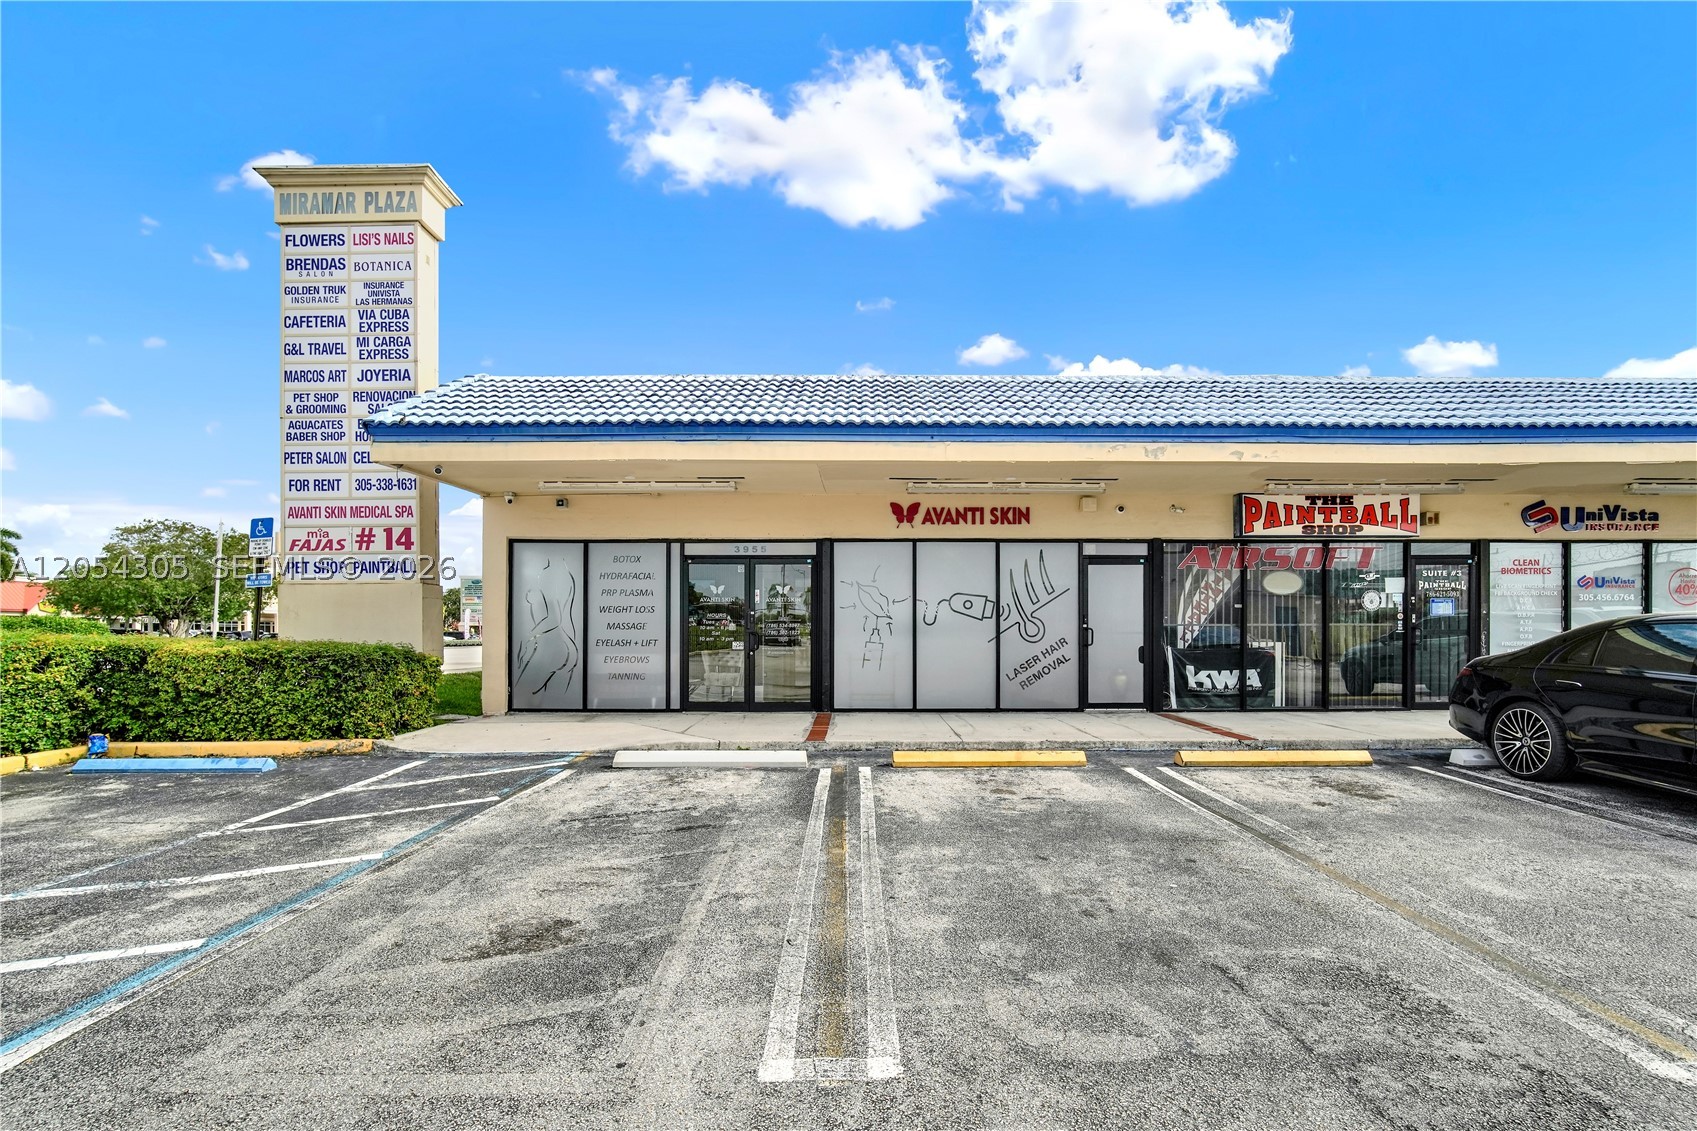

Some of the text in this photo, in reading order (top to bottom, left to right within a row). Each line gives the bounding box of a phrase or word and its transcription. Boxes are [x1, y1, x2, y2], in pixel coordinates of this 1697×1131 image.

[280, 191, 418, 215] MIRAMAR PLAZA
[285, 234, 346, 247] FLOWERS
[353, 232, 415, 246] LISI'S NAILS
[286, 258, 347, 271] BRENDAS
[354, 261, 412, 272] BOTANICA
[284, 286, 347, 296] GOLDEN TRUK
[292, 296, 339, 304] INSURANCE
[356, 297, 412, 306] LAS HERMANAS
[358, 309, 410, 321] VIA CUBA
[284, 315, 347, 329] CAFETERIA
[359, 321, 409, 333] EXPRESS
[356, 336, 412, 348] MI CARGA
[284, 343, 347, 356] G&L TRAVEL
[359, 349, 409, 360] EXPRESS
[284, 370, 347, 383] MARCOS ART
[357, 369, 411, 382] JOYERIA
[293, 393, 339, 403] PET SHOP
[353, 391, 416, 403] RENOVACION
[286, 404, 347, 414] & GROOMING
[288, 420, 343, 430] AGUACATES
[286, 431, 346, 442] BABER SHOP
[284, 452, 347, 465] PETER SALON
[354, 451, 373, 464] CEL
[289, 479, 342, 492] FOR RENT
[355, 478, 417, 491] 305-338-1631
[1305, 496, 1354, 506] THE
[288, 505, 414, 519] AVANTI SKIN MEDICAL SPA
[921, 506, 1031, 525] AVANTI SKIN
[1243, 496, 1418, 534] PAINTBALL
[1561, 505, 1660, 532] UniVista
[1302, 525, 1364, 535] SHOP
[355, 527, 415, 551] # 14
[289, 539, 347, 552] FAJAS
[1177, 546, 1384, 571] AIRSOFT
[1513, 559, 1540, 567] CLEAN
[600, 572, 656, 580] HYDRAFACIAL
[1418, 580, 1467, 590] PAINTBALL
[1595, 577, 1636, 588] UniVista
[1675, 584, 1697, 595] 40%
[635, 606, 655, 614] LOSS
[596, 639, 632, 647] EYELASH
[641, 639, 658, 647] LIFT
[604, 656, 650, 664] EYEBROWS
[1006, 637, 1069, 682] LASER HAIR
[1019, 654, 1072, 691] REMOVAL
[1185, 665, 1262, 689] KWA
